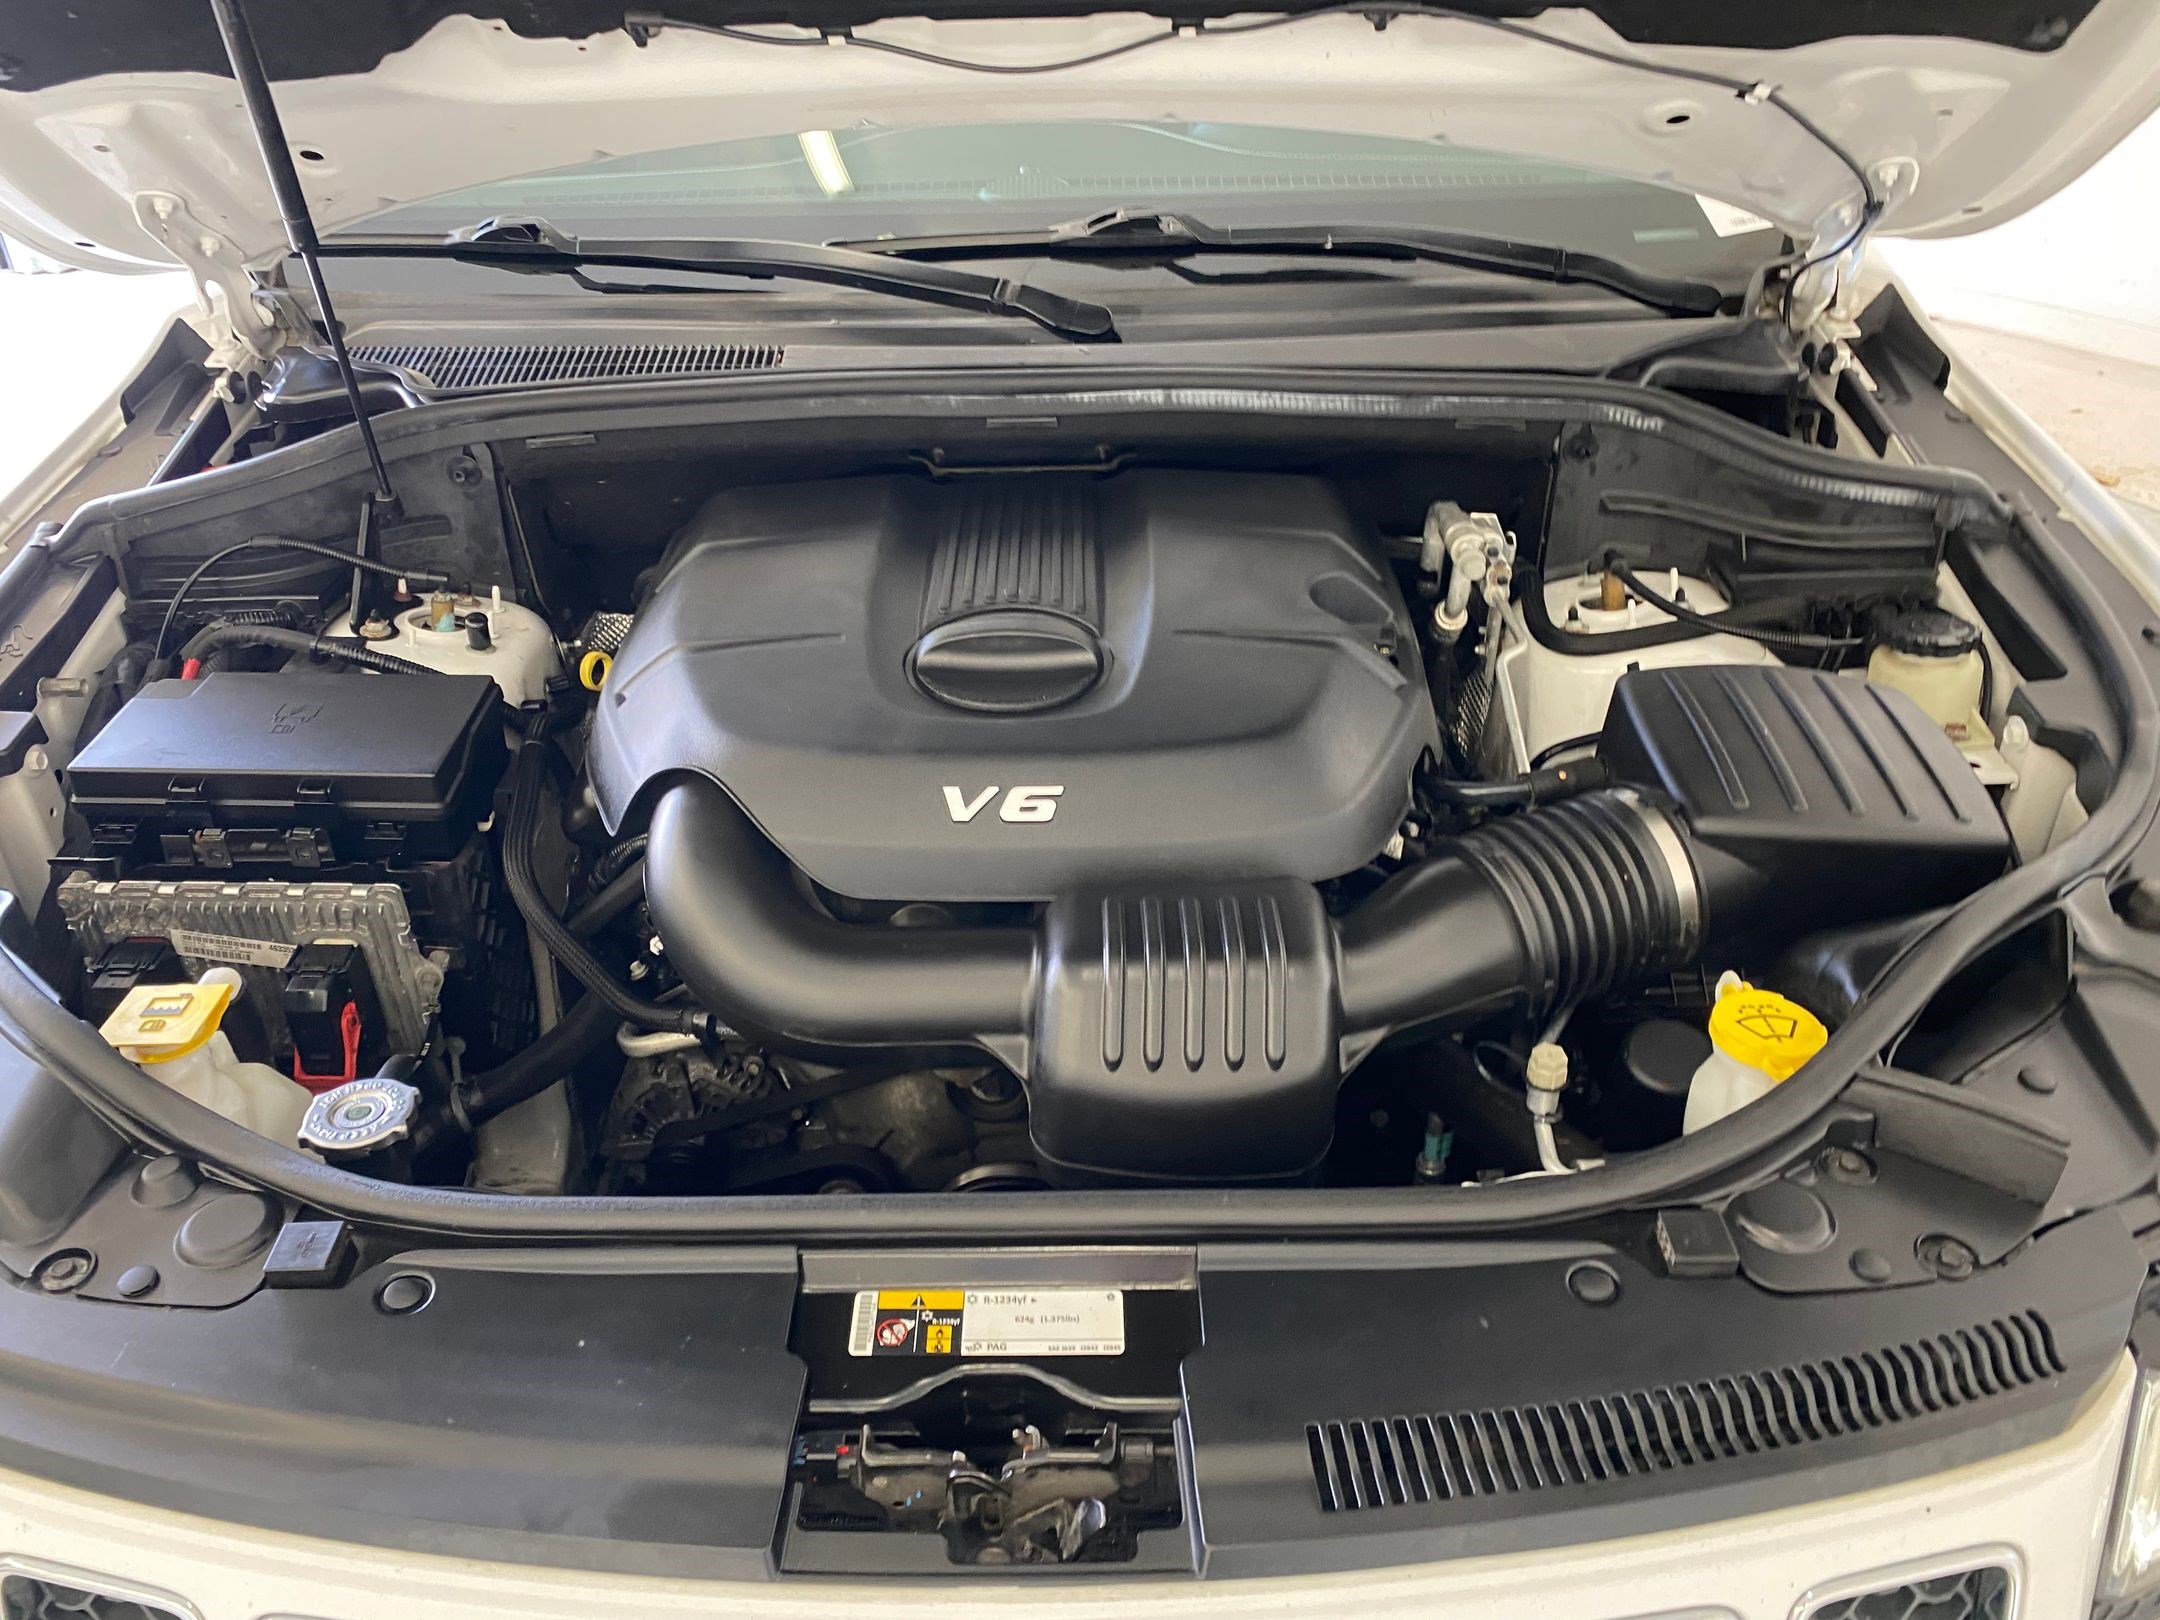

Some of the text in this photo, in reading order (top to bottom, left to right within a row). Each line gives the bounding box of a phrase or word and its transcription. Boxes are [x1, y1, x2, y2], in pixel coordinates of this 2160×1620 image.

[942, 785, 1065, 823] V6
[983, 1295, 1027, 1306] R-1234yf
[987, 1343, 1007, 1351] PAG
